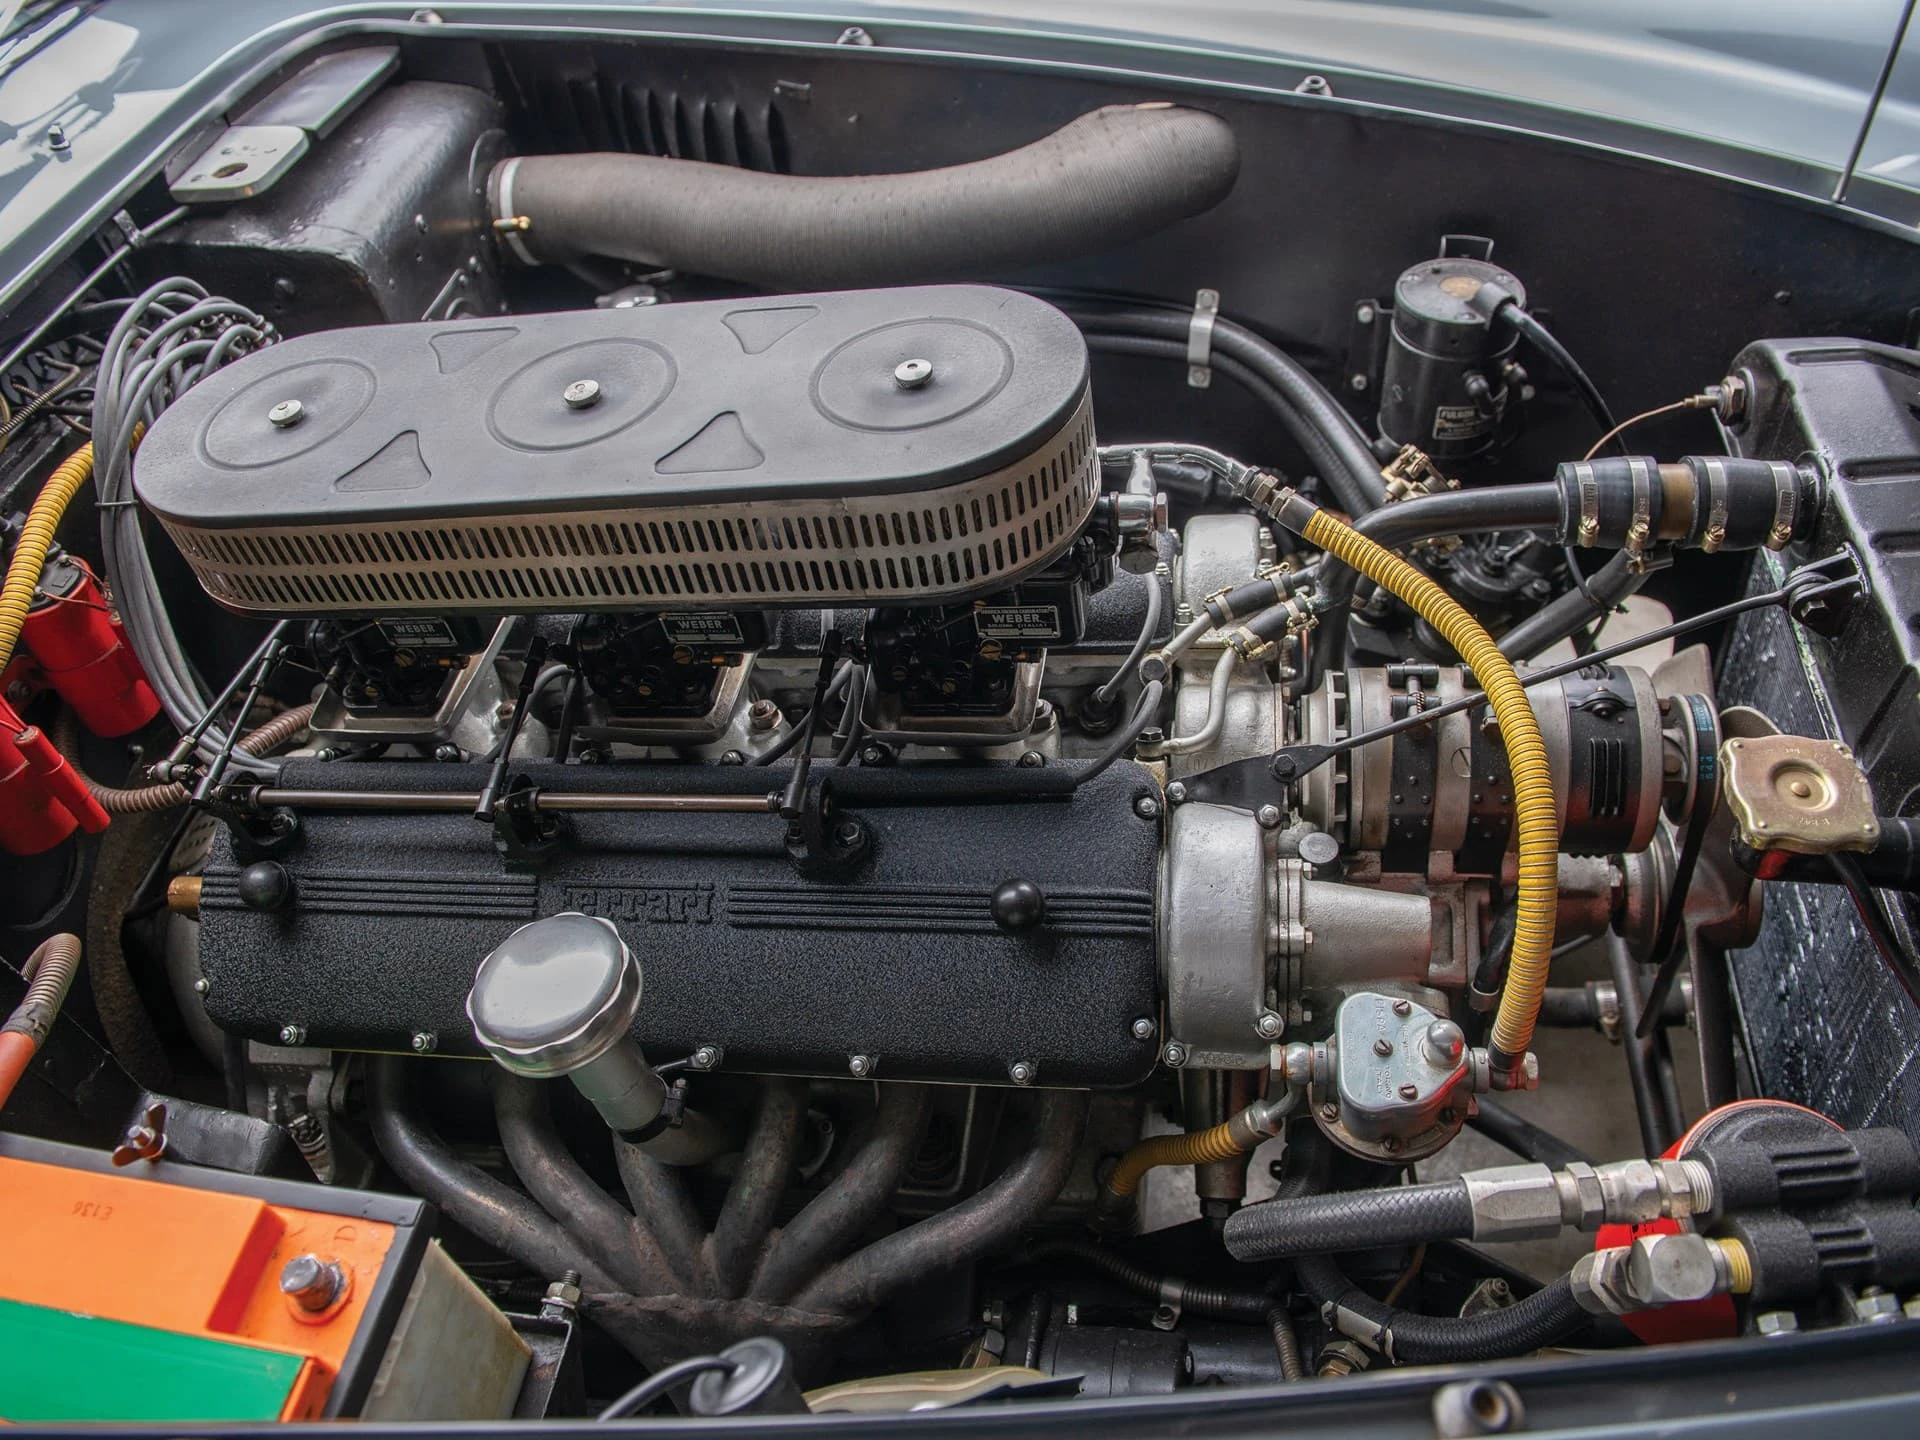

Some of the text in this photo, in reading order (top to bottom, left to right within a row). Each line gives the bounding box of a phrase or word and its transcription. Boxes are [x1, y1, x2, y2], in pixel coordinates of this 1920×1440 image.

[991, 613, 1041, 624] WEBER
[393, 623, 436, 634] WEBER
[677, 620, 724, 630] WEBER
[563, 881, 715, 924] Ferrari
